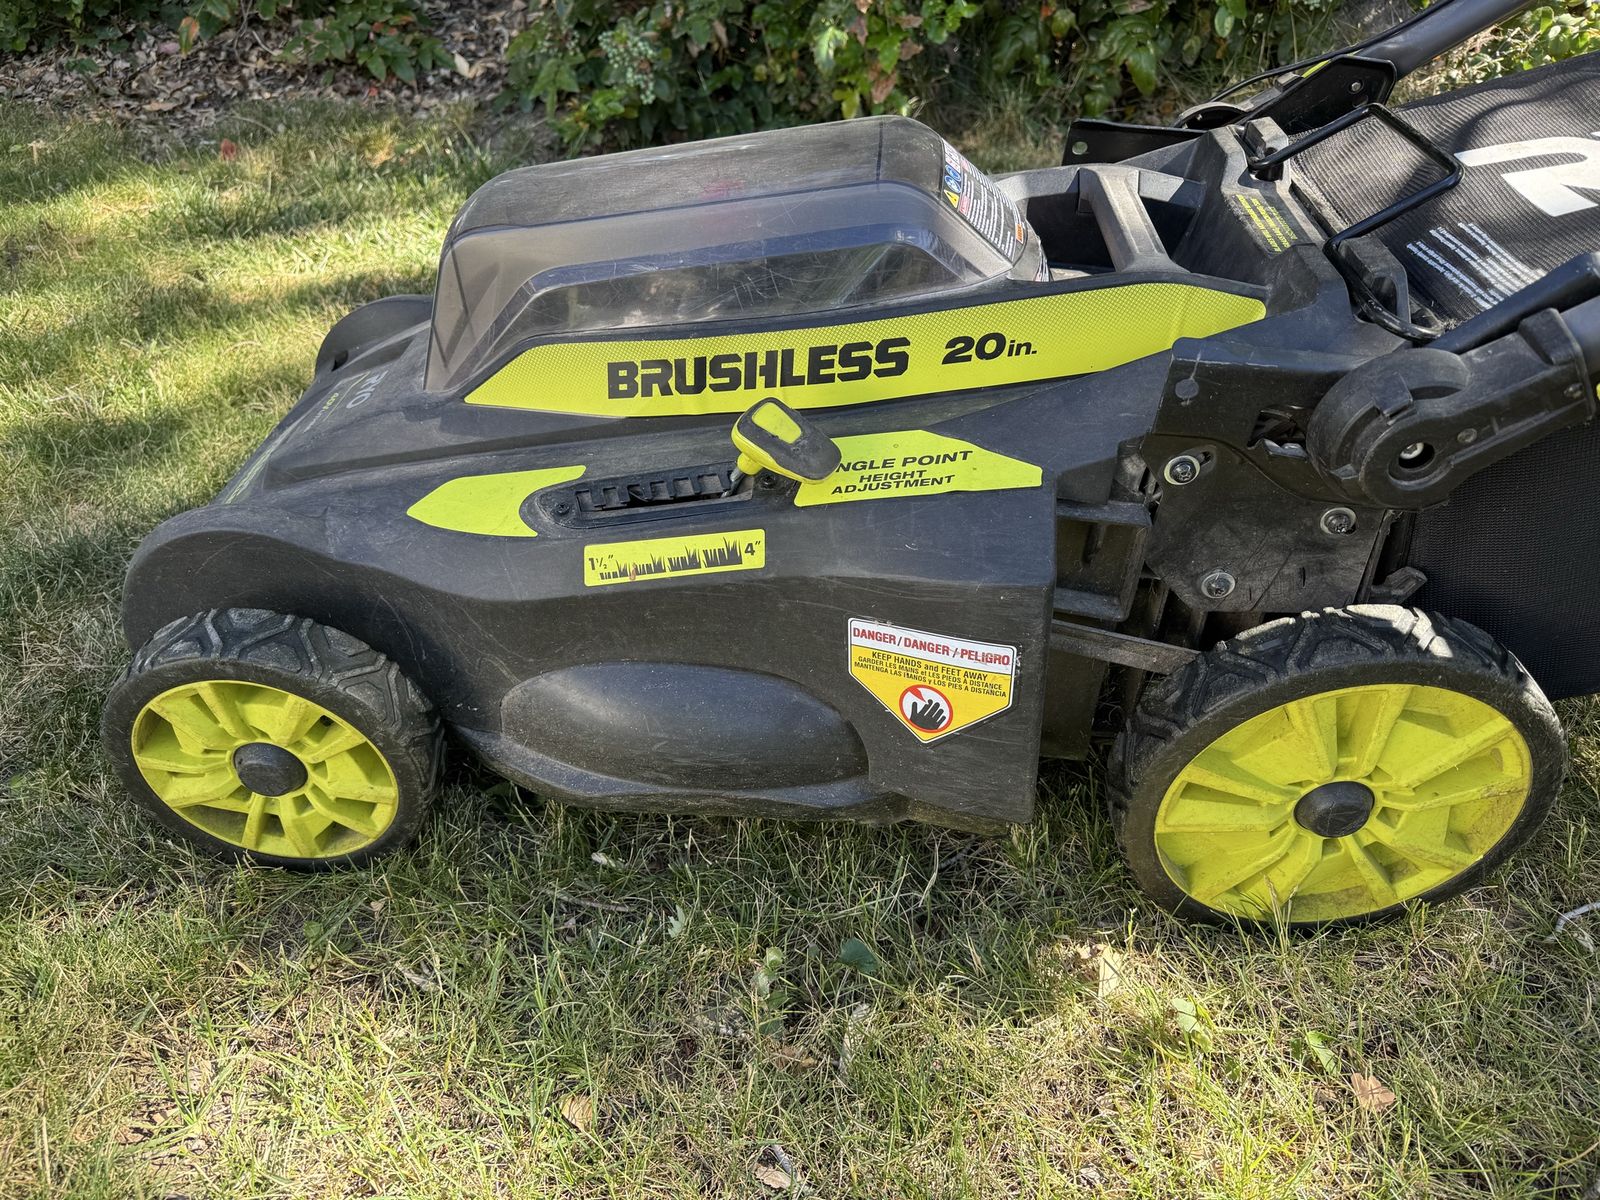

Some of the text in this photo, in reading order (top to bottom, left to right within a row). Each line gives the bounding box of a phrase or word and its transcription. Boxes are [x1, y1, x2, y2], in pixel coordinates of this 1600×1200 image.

[607, 337, 910, 399] BRUSHLESS
[836, 450, 973, 473] NGLE POINT
[859, 469, 928, 483] HEIGHT
[831, 474, 956, 495] ADJUSTMENT
[853, 627, 897, 645] DANGER
[903, 637, 950, 656] DANGER
[960, 648, 1010, 666] PELIGRO
[854, 661, 888, 674] MANTENGA
[889, 669, 902, 677] LAS
[947, 682, 963, 691] PIES
[970, 687, 1006, 697] DISTANCIA
[858, 656, 884, 667] GARDER
[885, 661, 897, 669] LES
[941, 674, 961, 684] PIEDS
[970, 680, 1002, 690] DISTANCE
[872, 651, 988, 682] KEEP HANDS and FEET AWAY
